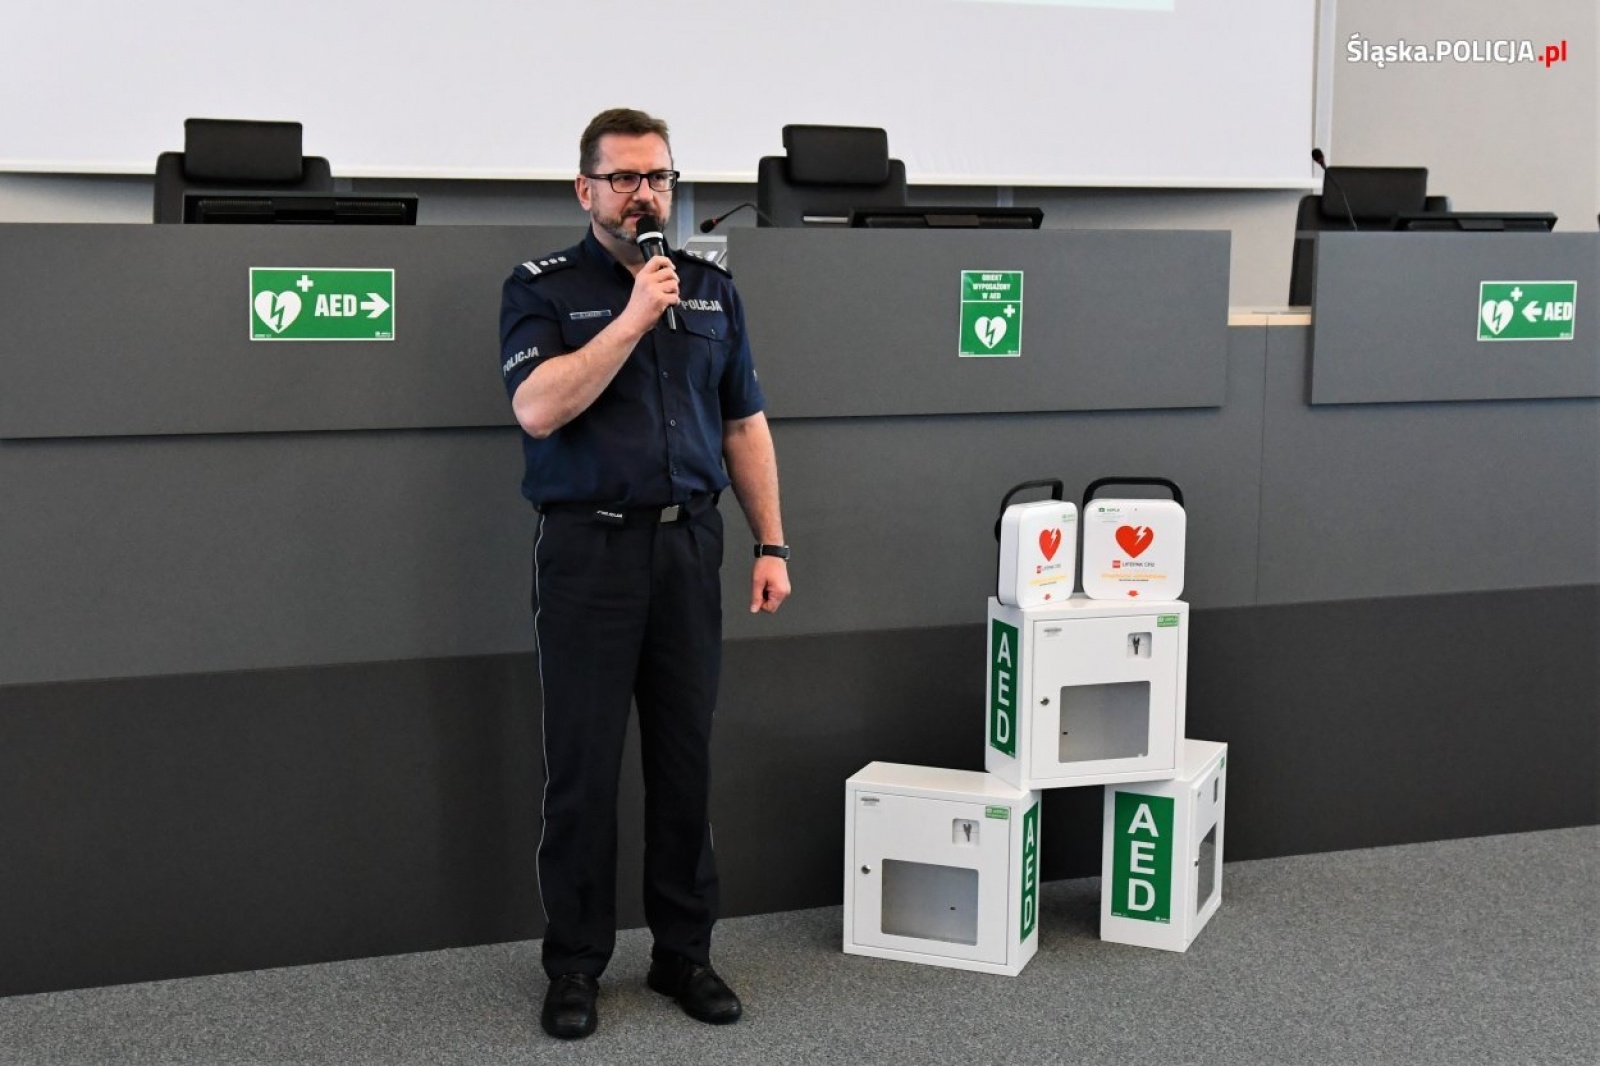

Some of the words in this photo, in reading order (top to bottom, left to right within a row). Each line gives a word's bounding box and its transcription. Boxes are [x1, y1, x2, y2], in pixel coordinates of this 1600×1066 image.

[314, 294, 358, 317] AED
[681, 299, 723, 312] POLICJA
[1543, 301, 1573, 321] AED
[503, 346, 539, 377] POLICJA
[997, 632, 1012, 744] AED
[1127, 803, 1159, 912] AED
[1024, 817, 1035, 931] AED
